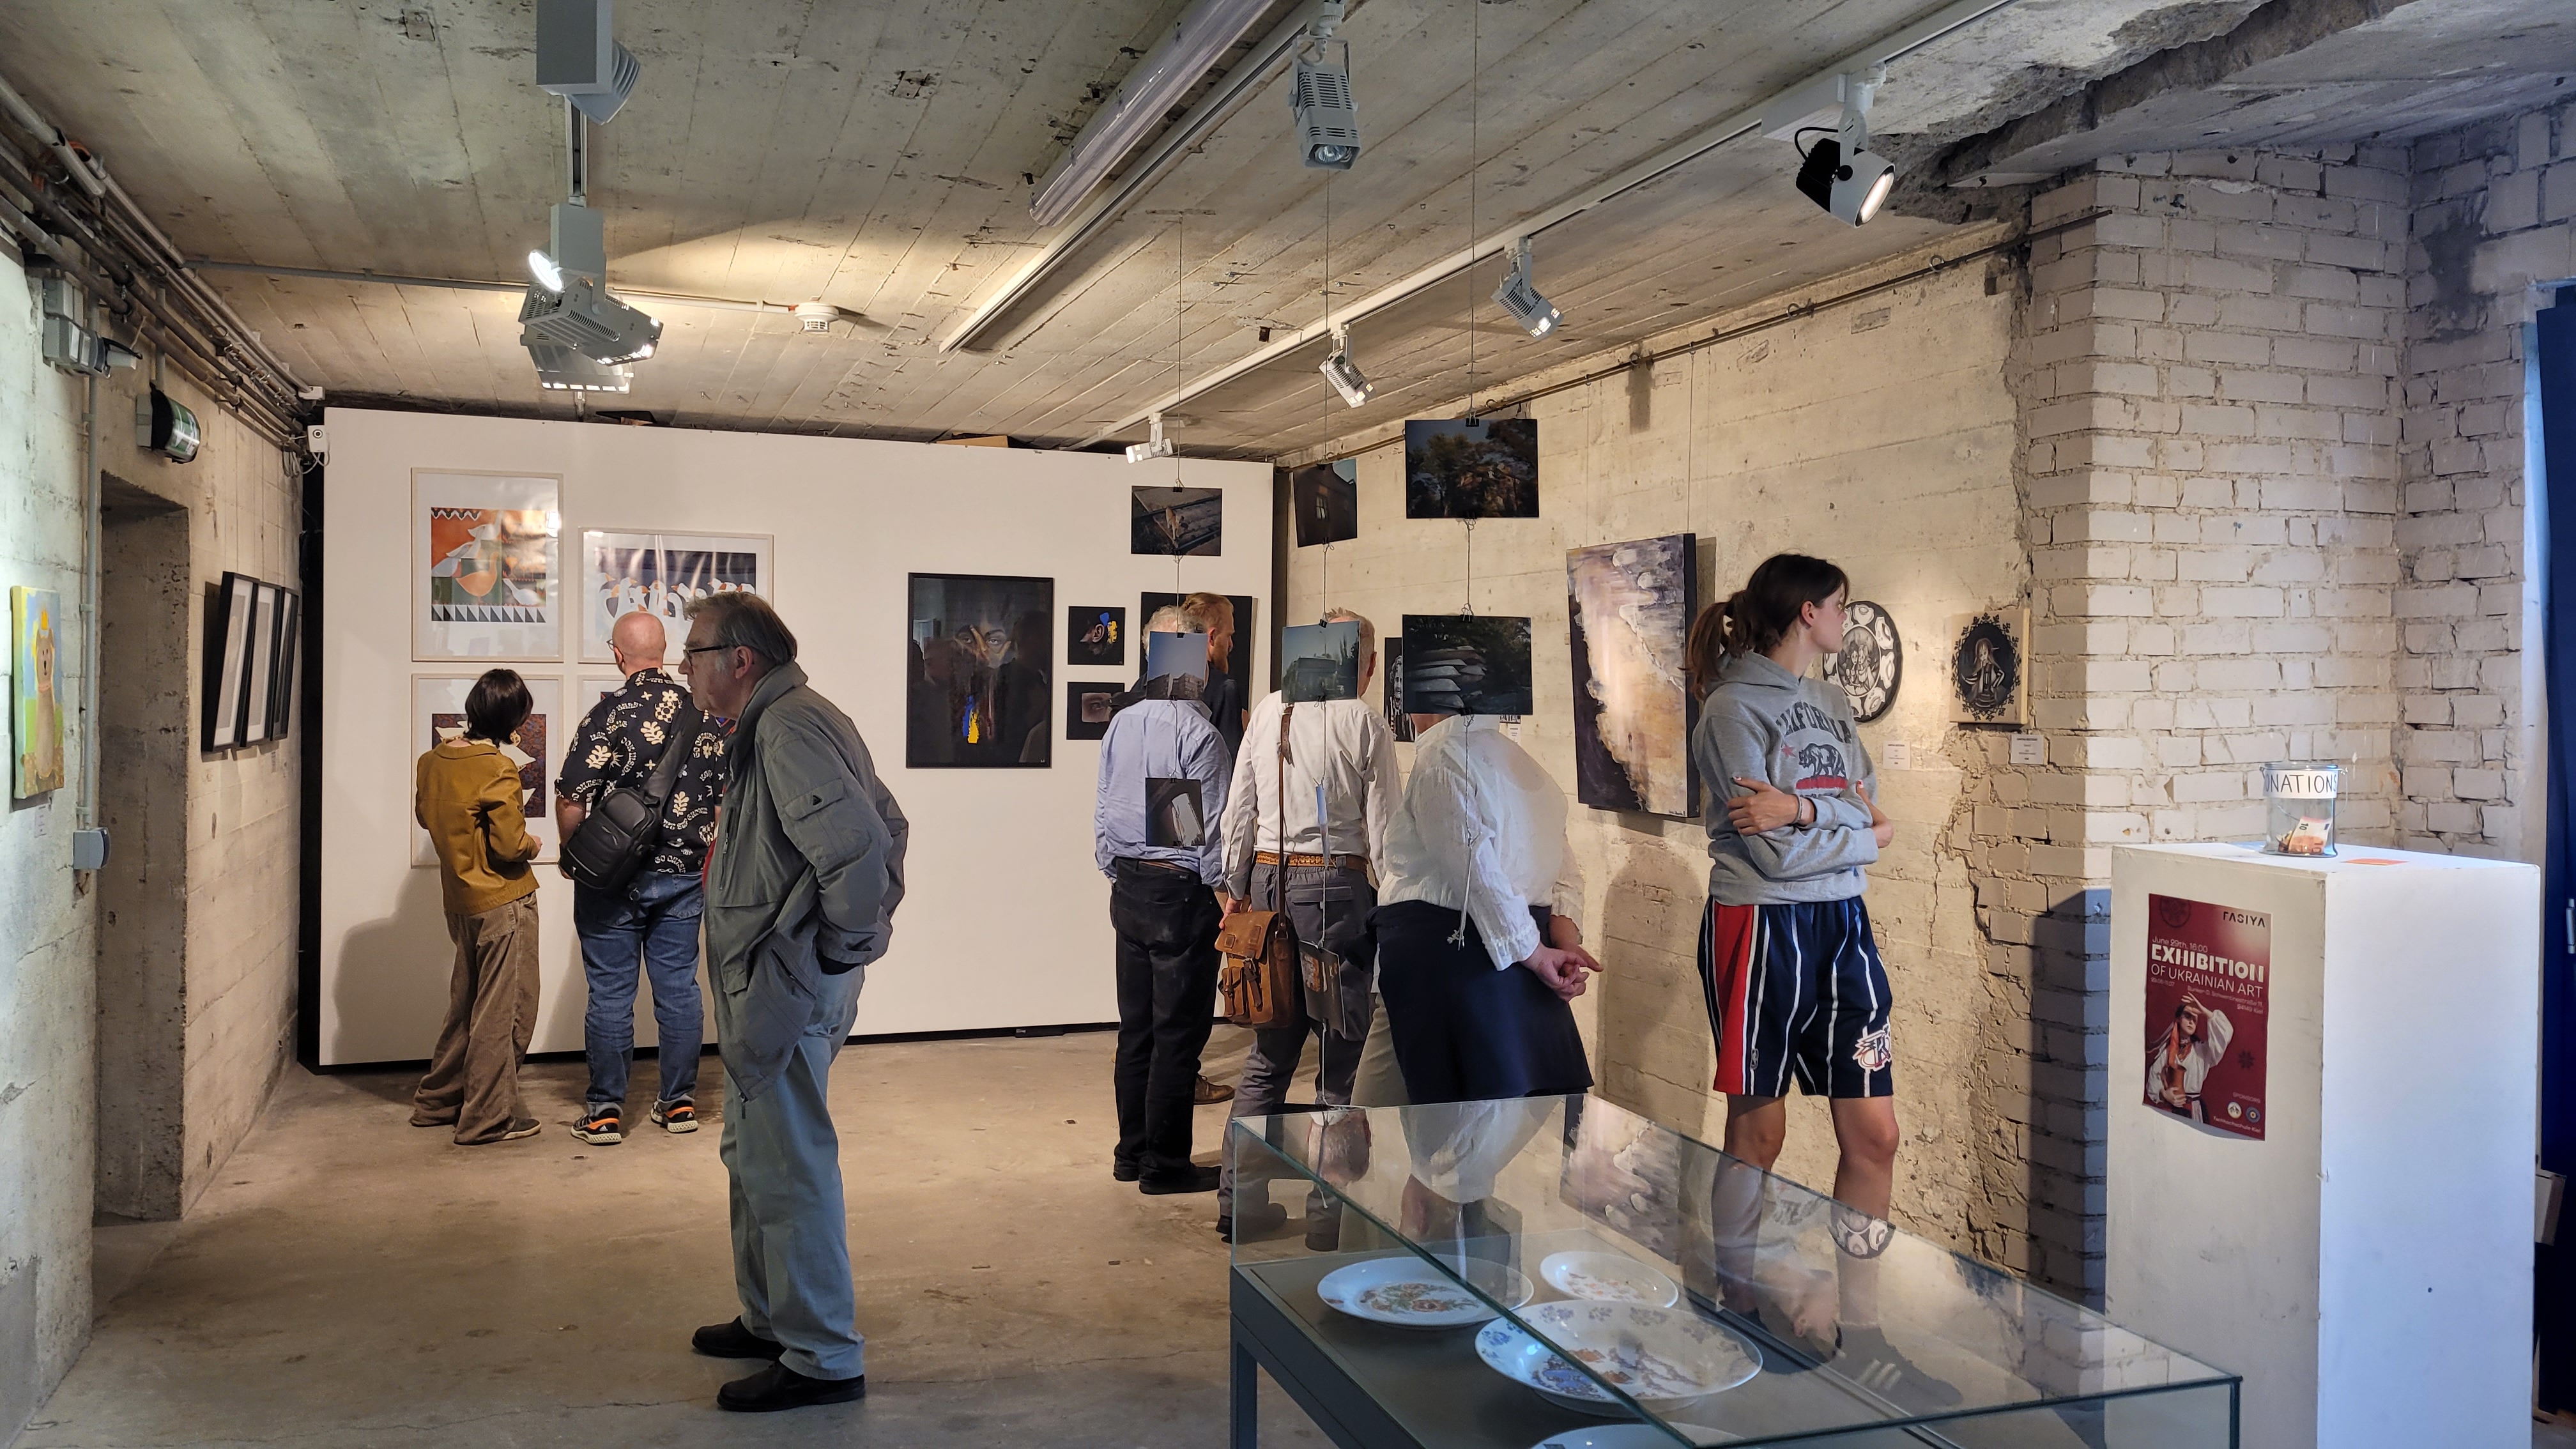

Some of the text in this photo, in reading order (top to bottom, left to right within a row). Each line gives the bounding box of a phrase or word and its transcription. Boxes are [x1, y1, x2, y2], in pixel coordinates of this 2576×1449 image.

[2152, 936, 2169, 945] June
[2150, 944, 2264, 983] EXHIBITION
[2150, 963, 2263, 998] OF UKRAINIAN ART
